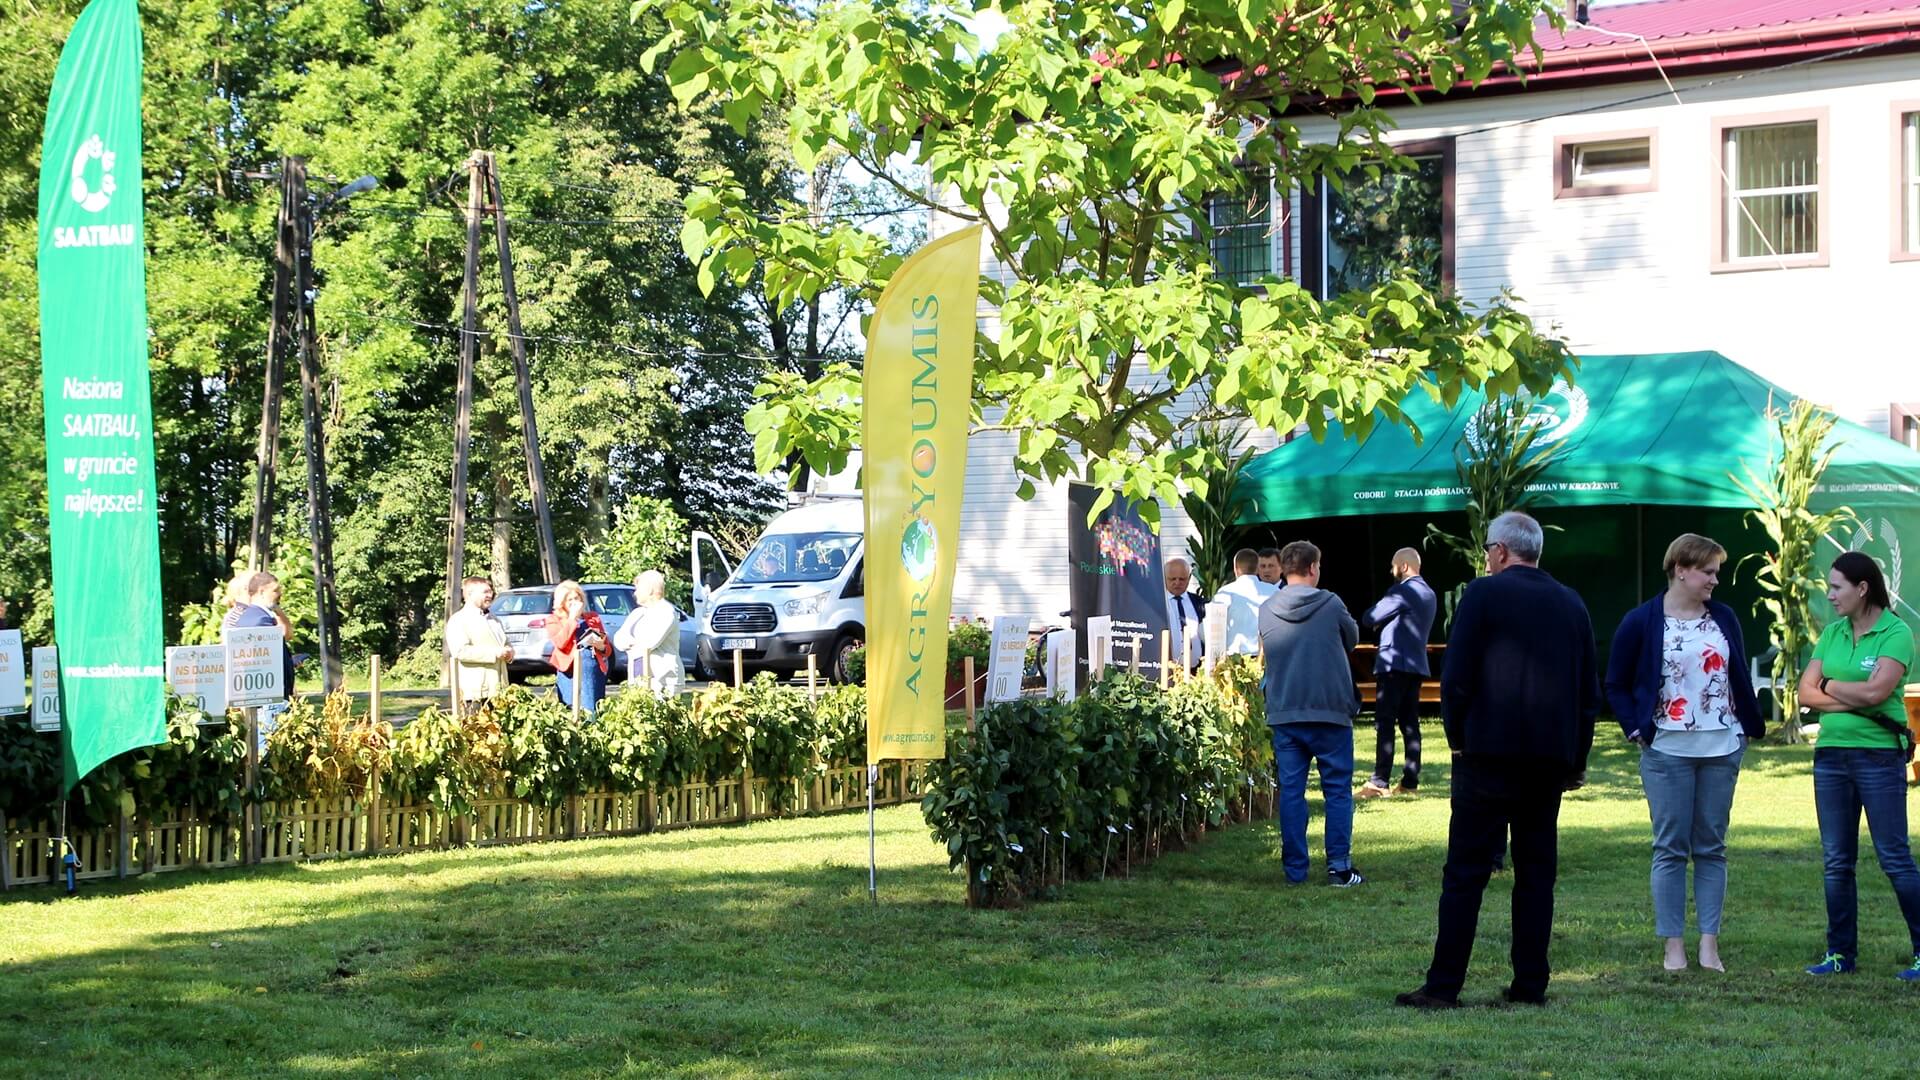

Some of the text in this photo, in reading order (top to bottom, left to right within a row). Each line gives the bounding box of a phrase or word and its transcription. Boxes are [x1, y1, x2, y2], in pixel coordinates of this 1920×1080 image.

[54, 225, 134, 248] SAATBAU
[63, 376, 123, 399] Nasiona
[63, 414, 141, 440] SAATBAU,
[64, 452, 138, 481] w gruncie
[1353, 491, 1387, 500] COBORU
[1394, 488, 1423, 498] STACJA
[1424, 485, 1474, 497] DOŚWIADCZ
[1523, 483, 1557, 492] ODMIAN
[1560, 482, 1568, 490] W
[1568, 481, 1620, 490] KRZYŻEWIE
[64, 488, 143, 518] najlepsze!
[232, 646, 270, 659] LAJMA
[233, 672, 275, 692] 0000
